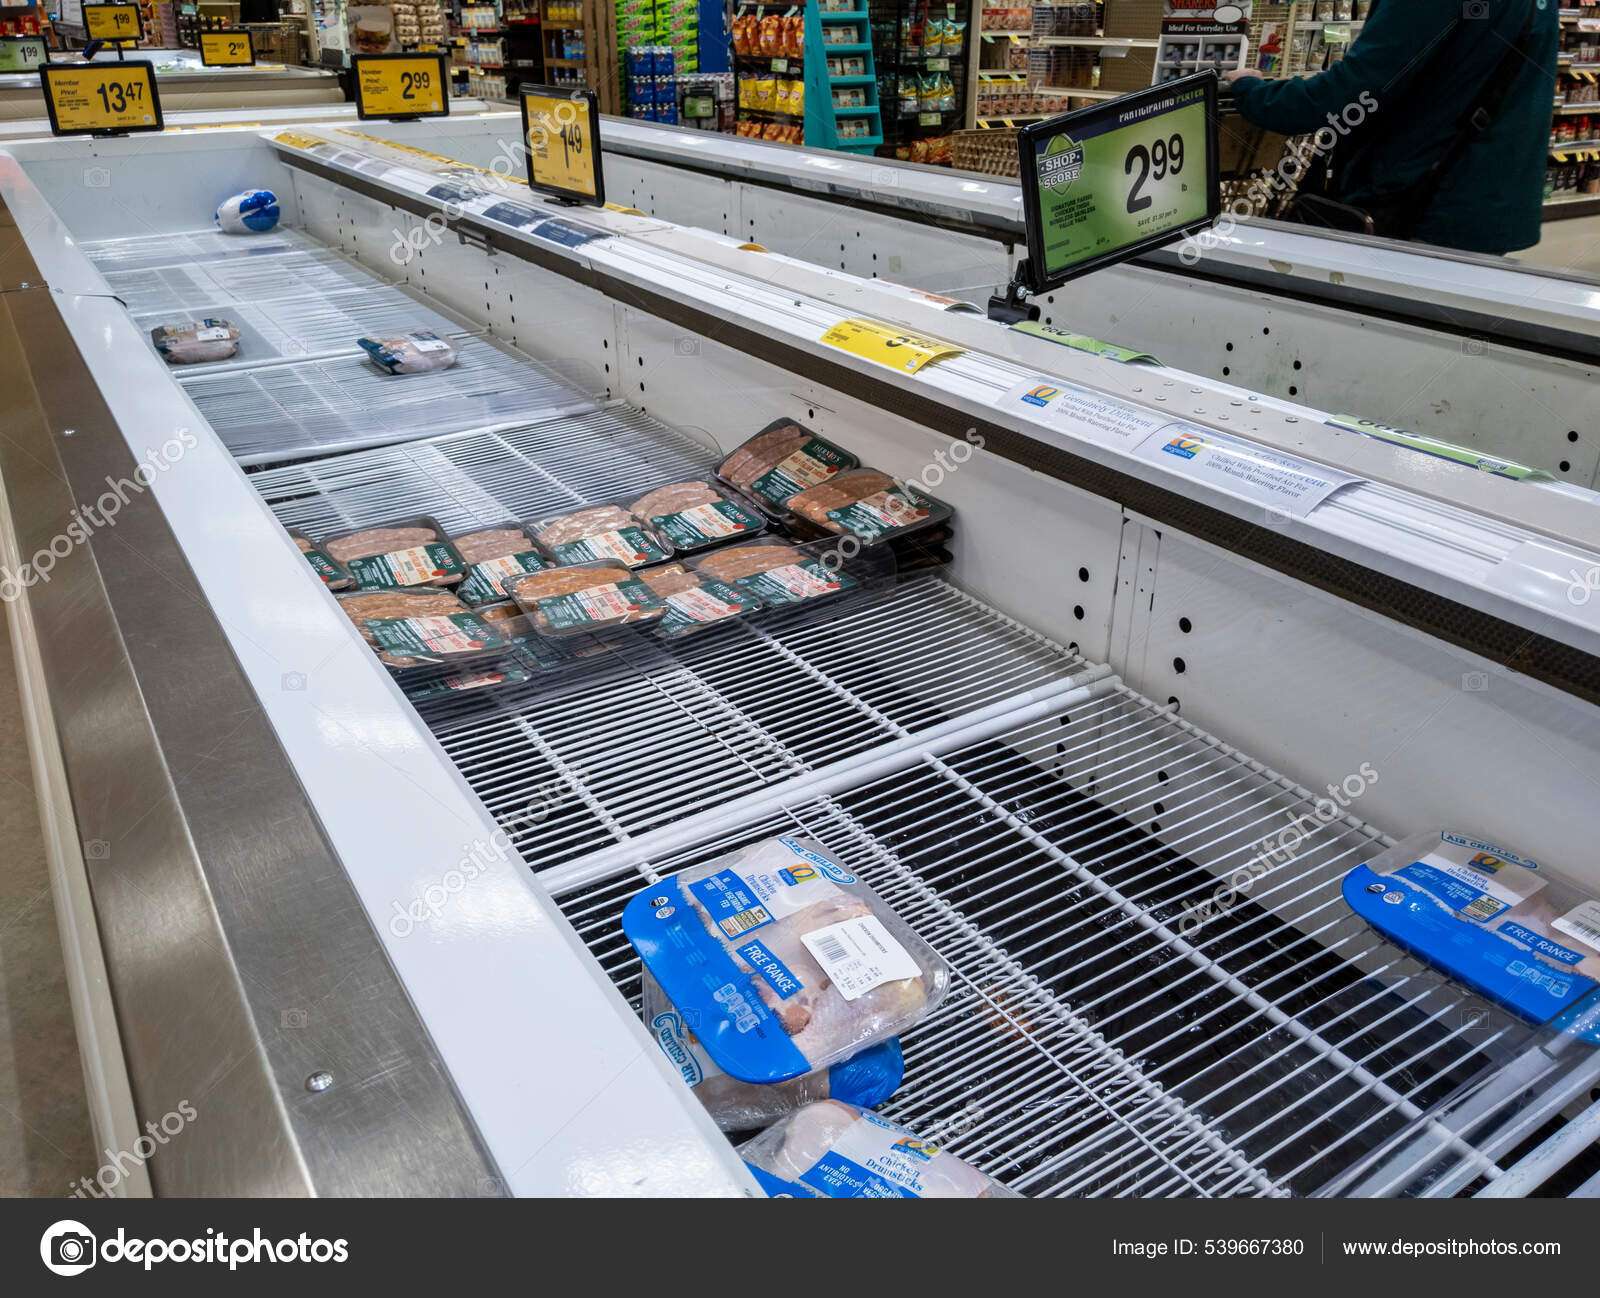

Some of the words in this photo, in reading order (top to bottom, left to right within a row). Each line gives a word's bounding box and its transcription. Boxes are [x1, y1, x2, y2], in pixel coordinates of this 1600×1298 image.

[1168, 24, 1183, 32] Ideal
[1184, 24, 1196, 32] For
[1196, 24, 1225, 33] Everyday
[1225, 24, 1238, 32] Use
[1045, 152, 1077, 171] SHOP
[1042, 168, 1081, 190] SCORE
[1276, 484, 1302, 499] Flavor
[1447, 834, 1467, 845] AIR
[1470, 840, 1520, 861] CHILLED
[719, 898, 731, 909] FED
[1505, 924, 1537, 944] FREE
[1536, 940, 1578, 962] RANGE
[743, 944, 770, 966] FREE
[763, 961, 797, 993] RANGE
[661, 1027, 687, 1064] CHILLED
[681, 1062, 697, 1084] AIR
[818, 1163, 860, 1188] ANTIBIOTICS
[838, 1164, 850, 1174] NO
[866, 1157, 923, 1192] Drumsticks
[879, 1154, 921, 1178] Chicken
[823, 1174, 842, 1187] EVER
